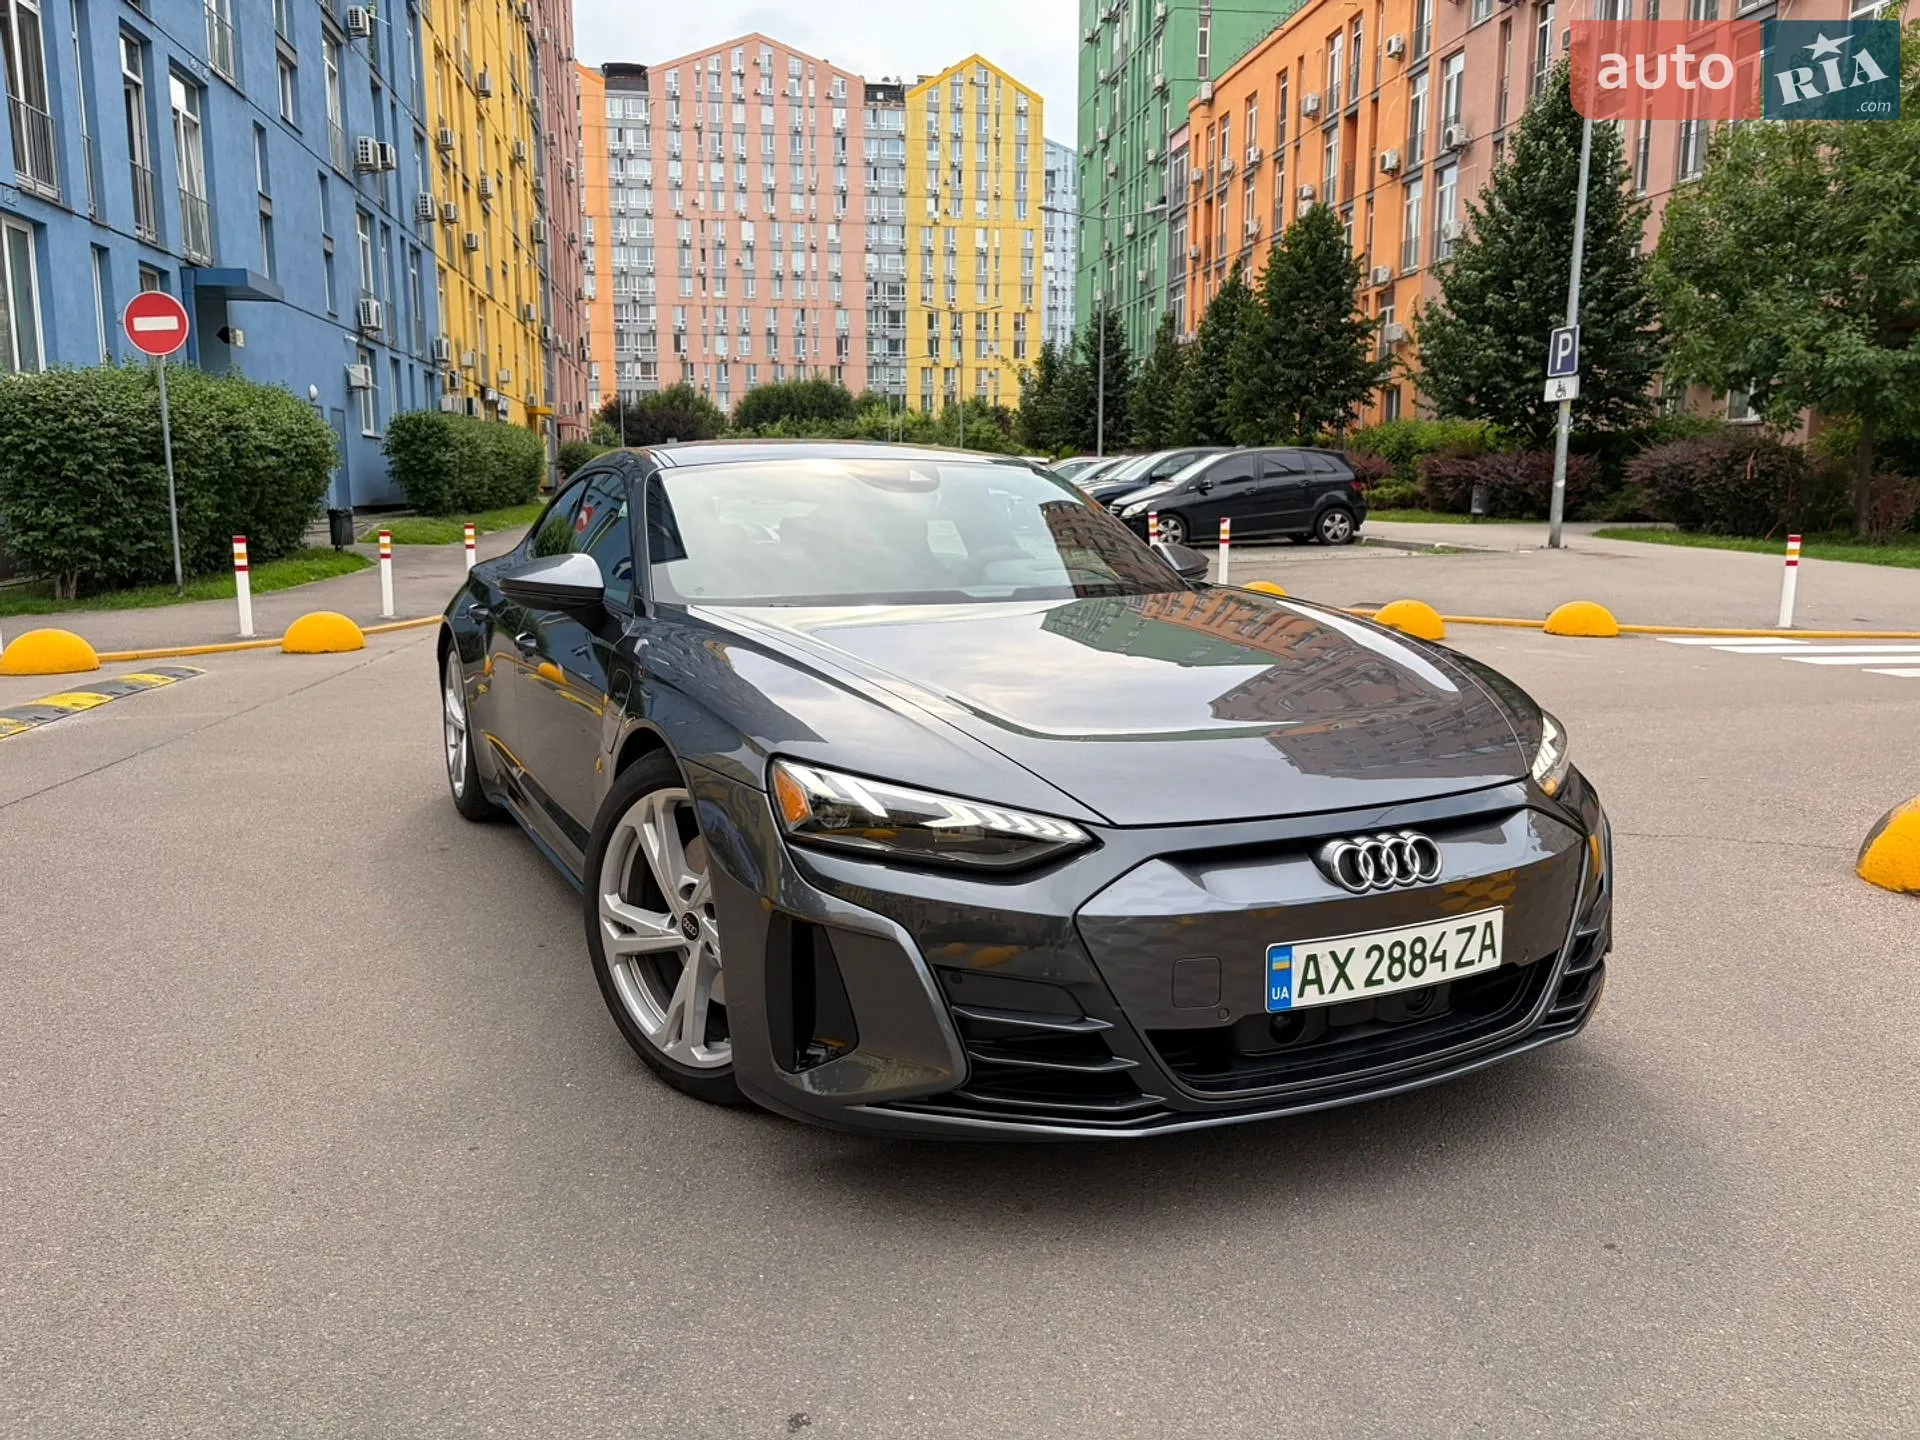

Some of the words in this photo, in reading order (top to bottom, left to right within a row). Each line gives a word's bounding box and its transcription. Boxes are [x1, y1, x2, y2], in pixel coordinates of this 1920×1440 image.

[1556, 333, 1573, 370] P
[1297, 947, 1356, 998] AX
[1364, 931, 1447, 988] 2884
[1455, 920, 1497, 970] ZA
[1272, 986, 1290, 1000] UA
